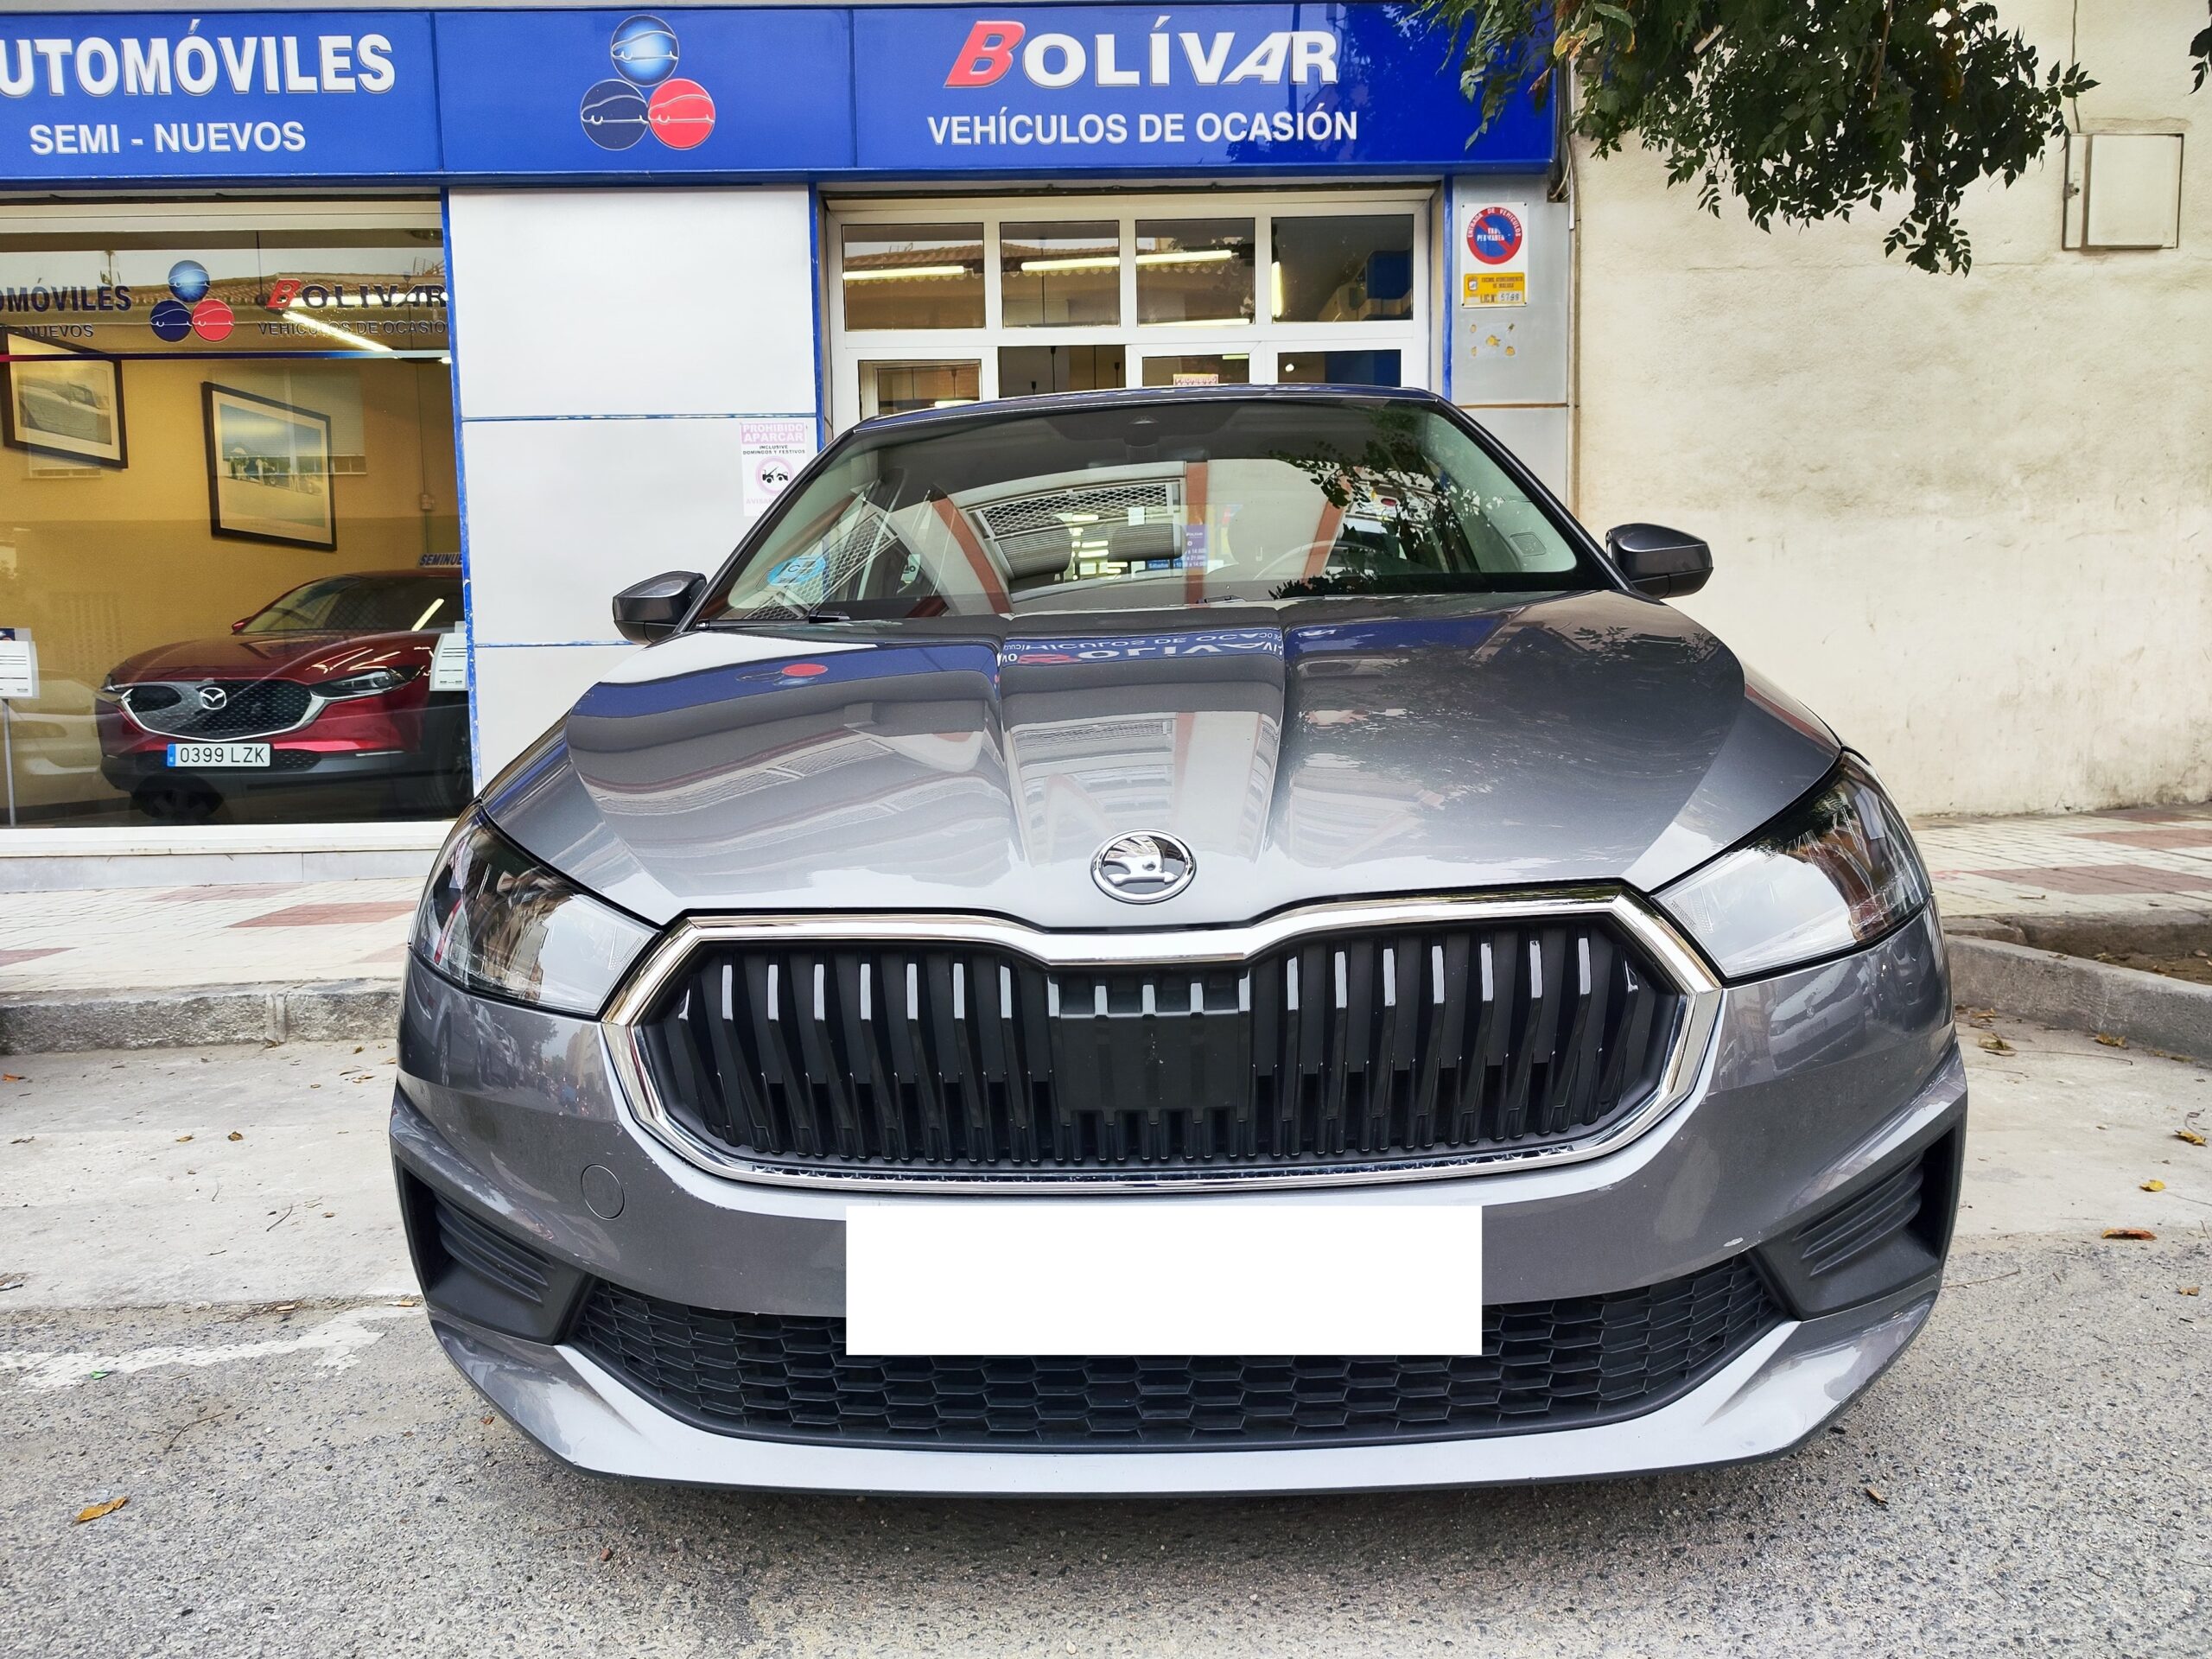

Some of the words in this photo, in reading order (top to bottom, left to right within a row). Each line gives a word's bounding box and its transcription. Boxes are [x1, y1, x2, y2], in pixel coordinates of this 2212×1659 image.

[944, 16, 1338, 89] BOLÍVAR
[927, 107, 1128, 145] VEHÍCULOS
[1138, 111, 1185, 143] DE
[1196, 103, 1357, 143] OCASIÓN
[29, 124, 120, 156] SEMI
[154, 121, 307, 154] NUEVOS
[0, 277, 132, 313] MÓVILES
[24, 325, 94, 338] NUEVOS
[357, 321, 378, 334] DE
[743, 423, 803, 433] PROHIBIDO
[743, 432, 804, 442] APARCAR
[180, 747, 224, 762] 0399
[231, 747, 264, 763] LZK
